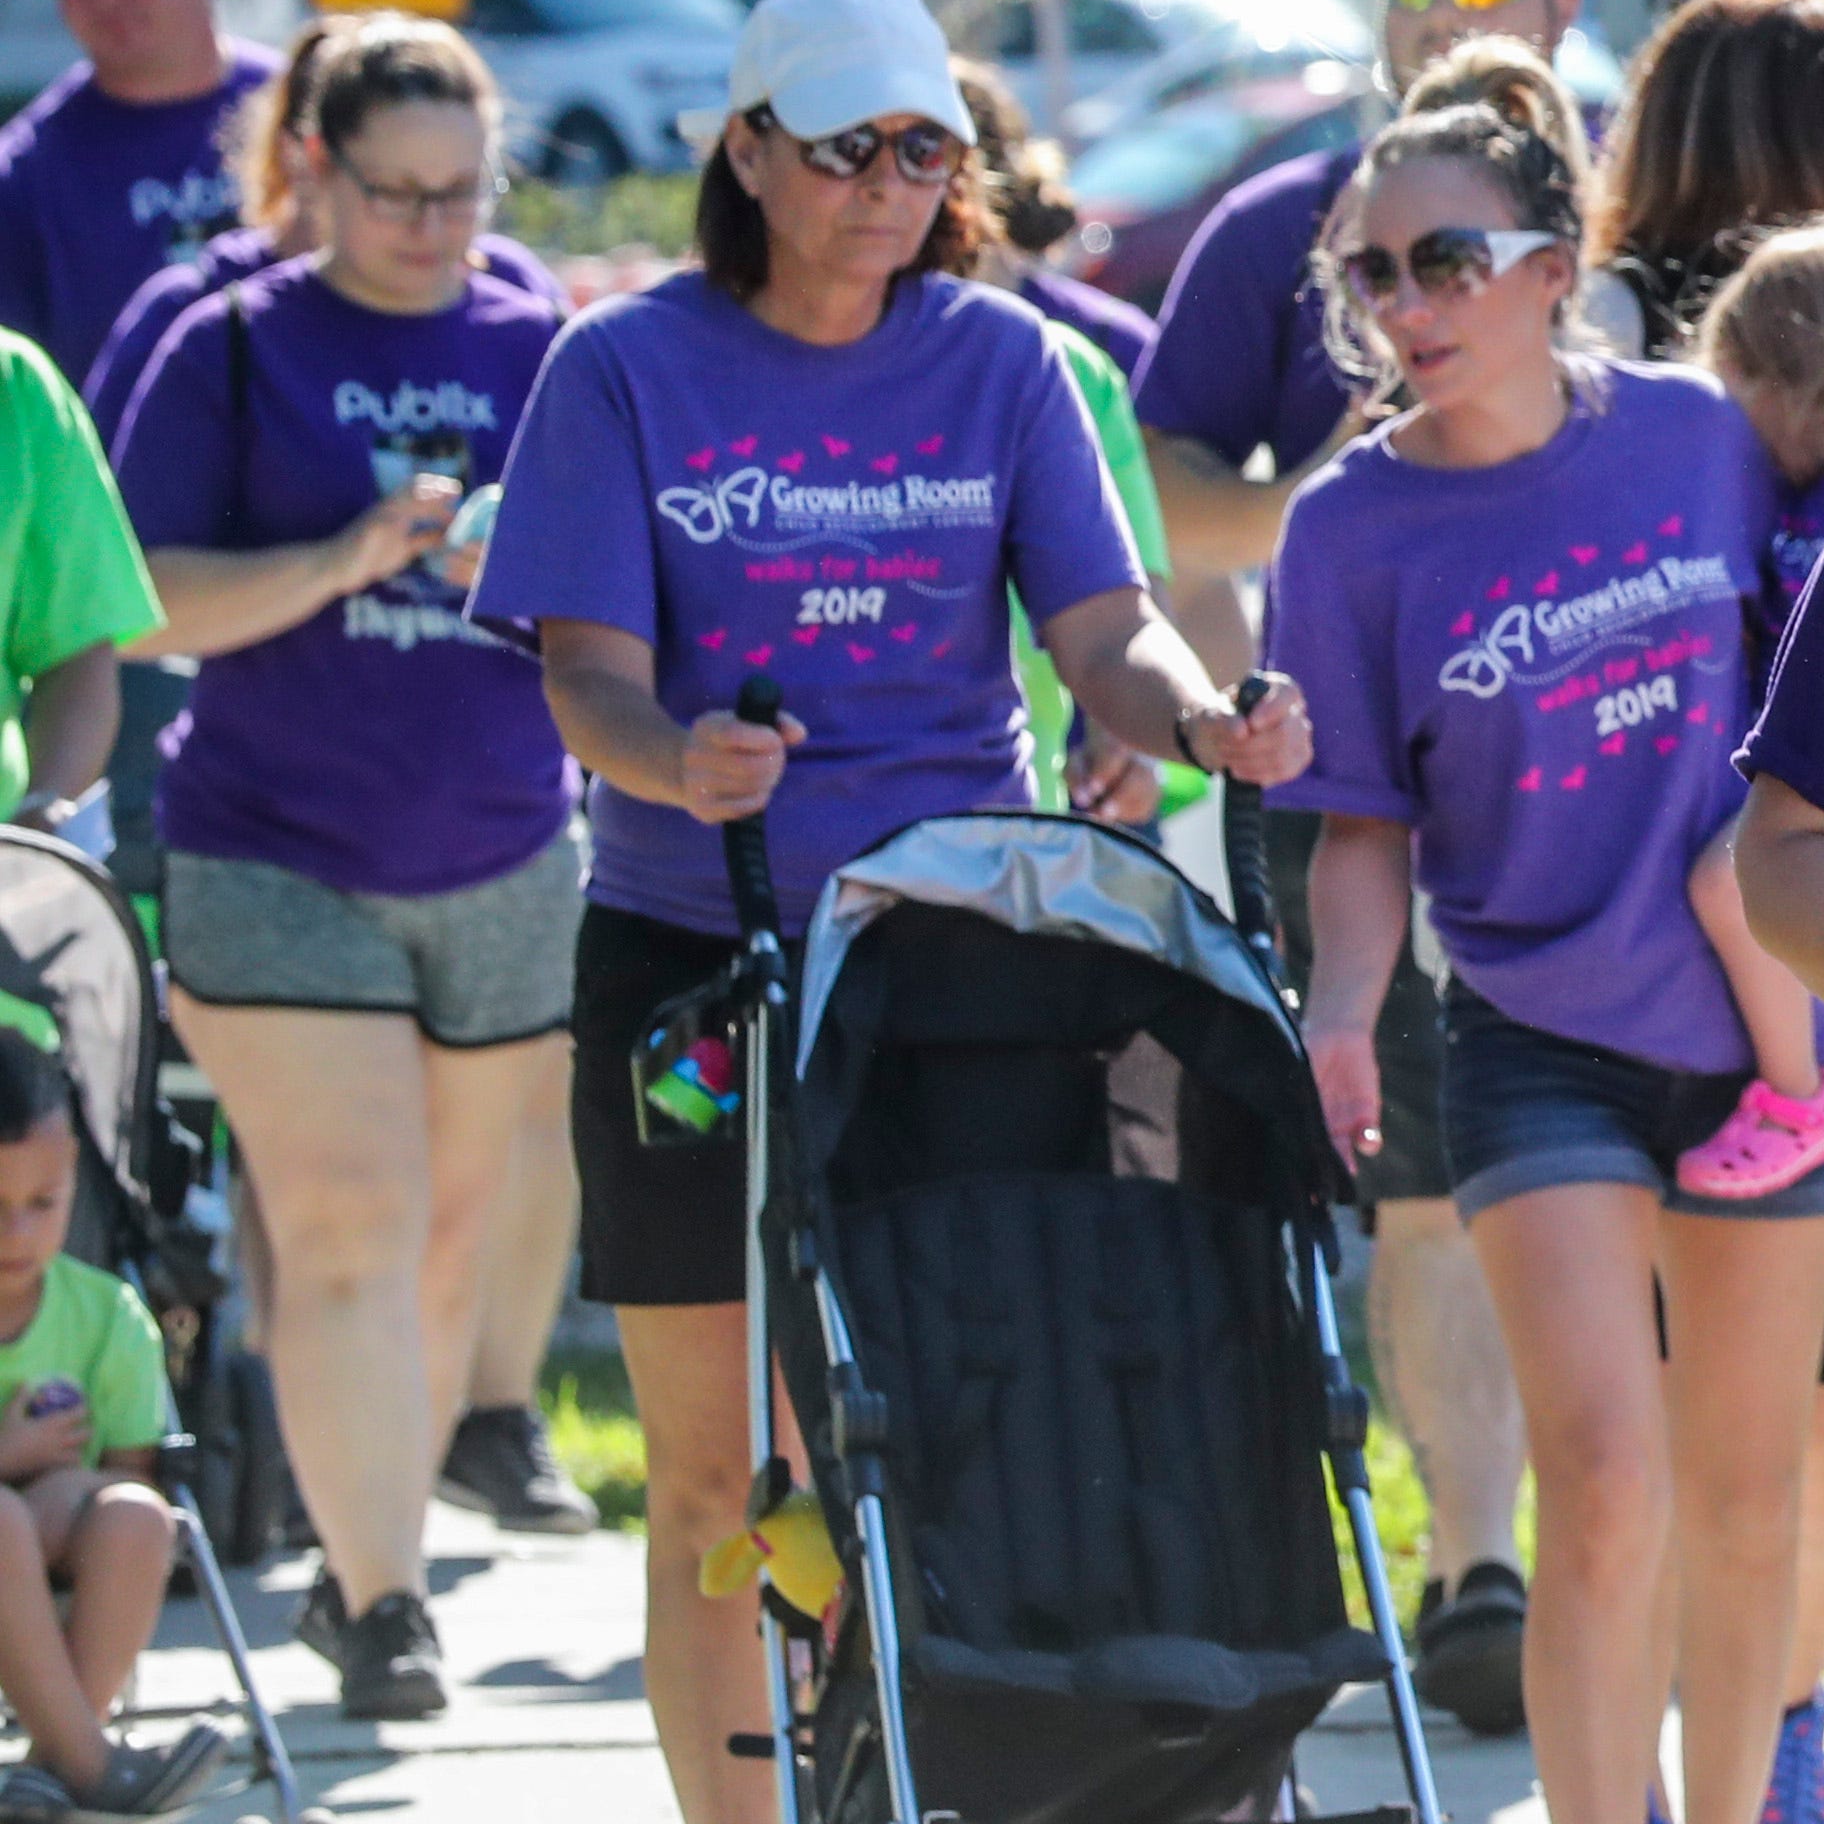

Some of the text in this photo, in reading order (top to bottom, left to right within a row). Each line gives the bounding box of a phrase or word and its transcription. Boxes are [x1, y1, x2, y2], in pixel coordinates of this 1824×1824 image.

[333, 378, 499, 433] Publix
[770, 473, 996, 521] Growing Room
[819, 554, 857, 581] for
[796, 586, 887, 626] 2019
[1533, 567, 1669, 638] Growing
[1593, 673, 1679, 736] 2019
